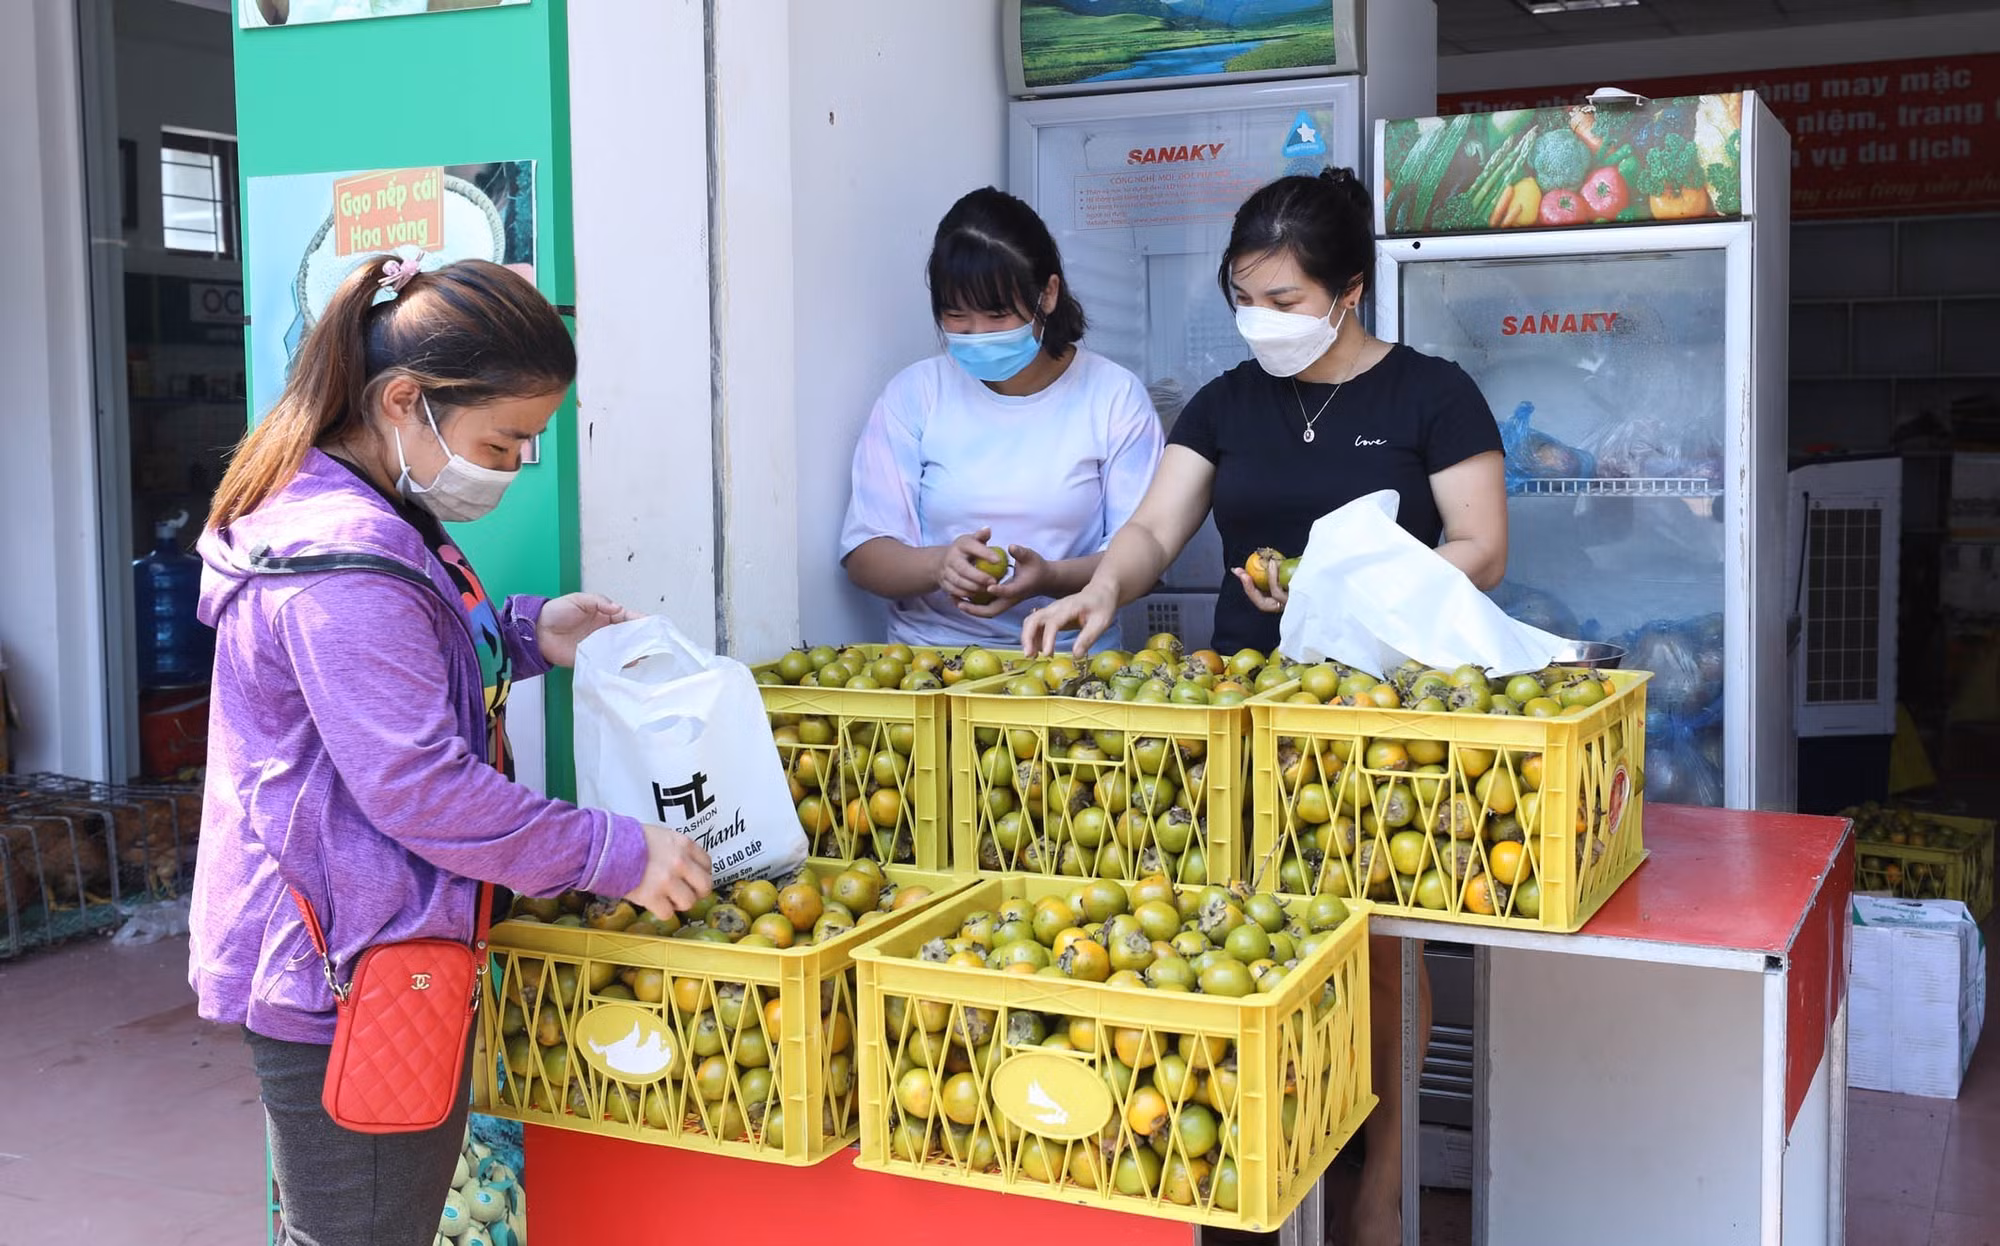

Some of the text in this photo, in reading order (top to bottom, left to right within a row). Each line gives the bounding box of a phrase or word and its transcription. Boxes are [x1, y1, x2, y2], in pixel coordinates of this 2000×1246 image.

[1822, 76, 1888, 98] may
[1901, 64, 1972, 94] mặc
[1898, 102, 1984, 127] trang
[1127, 143, 1224, 165] SANAKY
[1812, 147, 1847, 170] vụ
[1858, 140, 1898, 164] du
[1909, 135, 1972, 166] lịch
[341, 169, 437, 221] Gạo nếp cái
[350, 215, 428, 253] Hoa vàng
[1501, 311, 1617, 336] SANAKY
[675, 807, 718, 835] FASHION
[727, 850, 745, 867] CAO
[745, 839, 763, 858] CẤP
